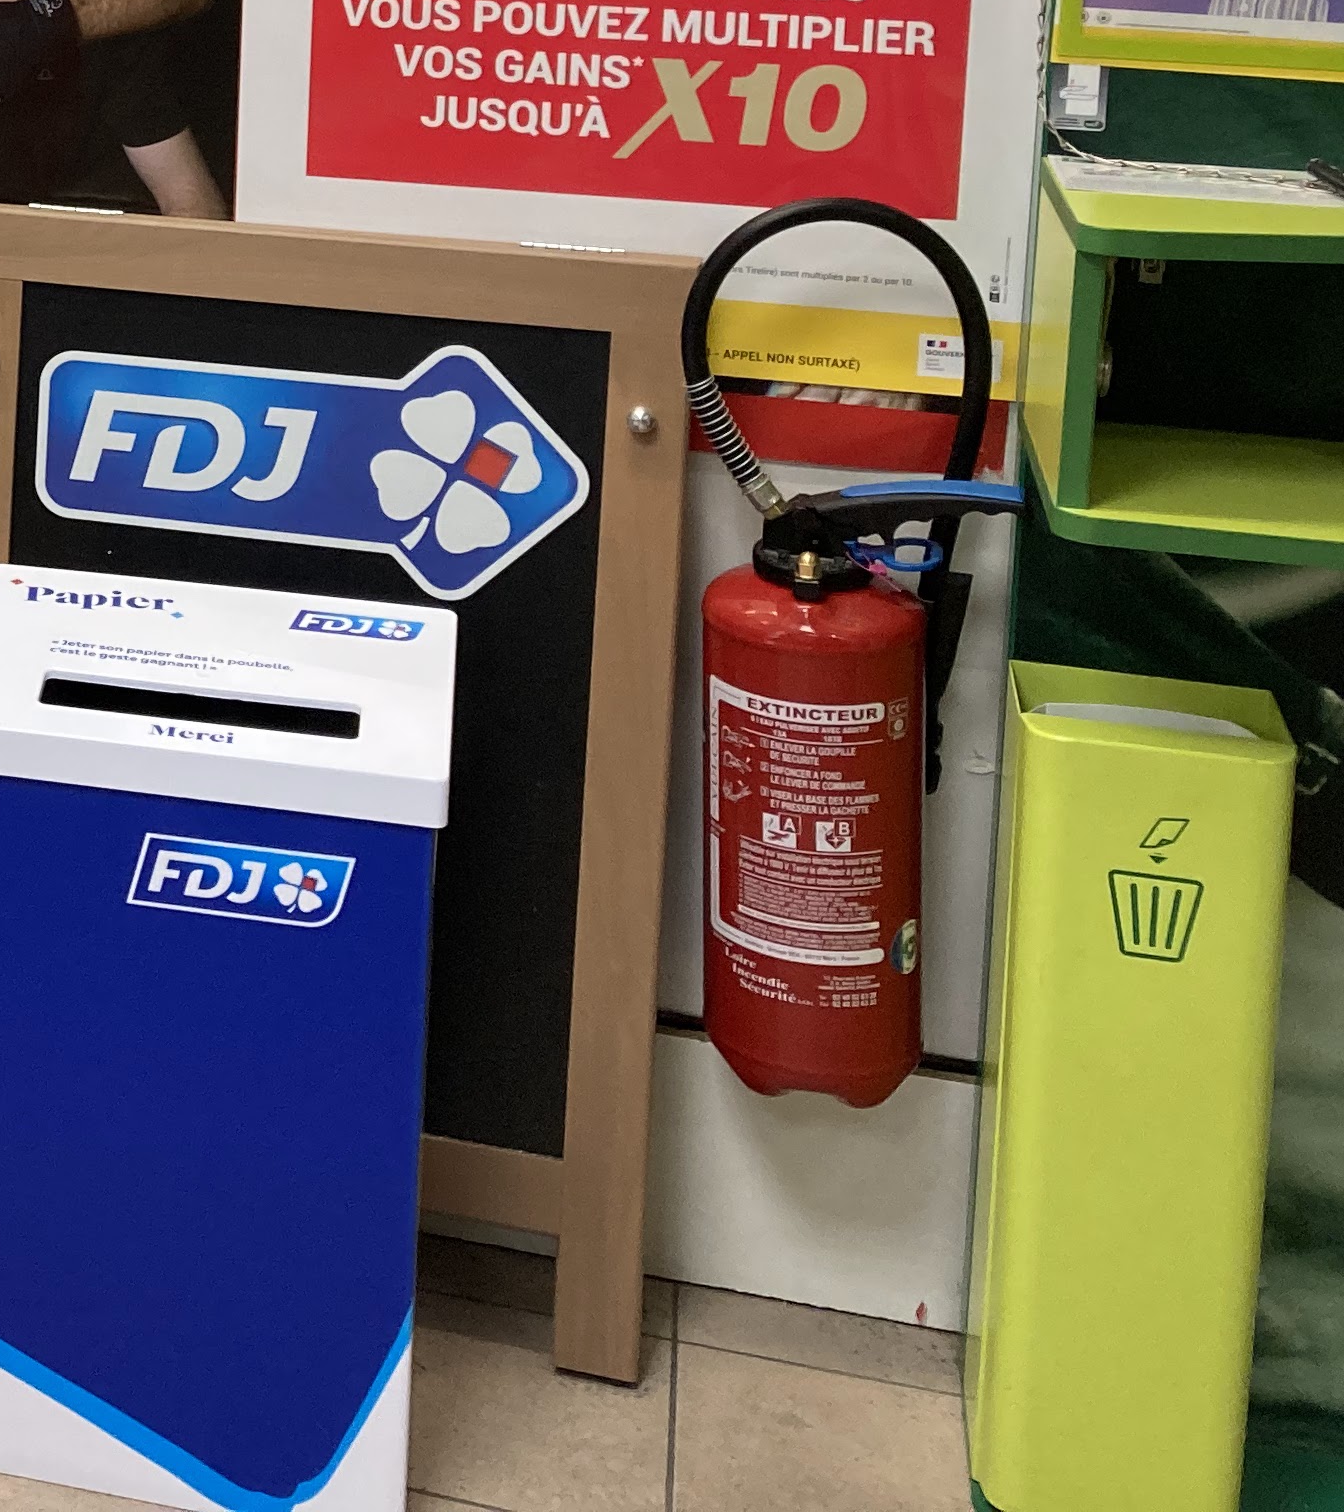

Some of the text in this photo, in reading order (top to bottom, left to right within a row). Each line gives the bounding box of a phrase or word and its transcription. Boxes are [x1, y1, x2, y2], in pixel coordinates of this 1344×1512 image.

[662, 9, 935, 57] MULTIPLIER
[420, 57, 868, 160] JUSQU'À X10
[724, 349, 861, 372] APPEL NON SURTAXÉ)
[69, 390, 318, 502] FDJ
[296, 613, 372, 637] FDJ
[99, 644, 124, 653] son
[127, 646, 171, 659] papier
[174, 651, 208, 662] dans
[211, 655, 224, 664] la
[747, 696, 879, 722] EXTINCTEUR
[150, 724, 234, 744] Merci
[147, 850, 267, 904] FDJ
